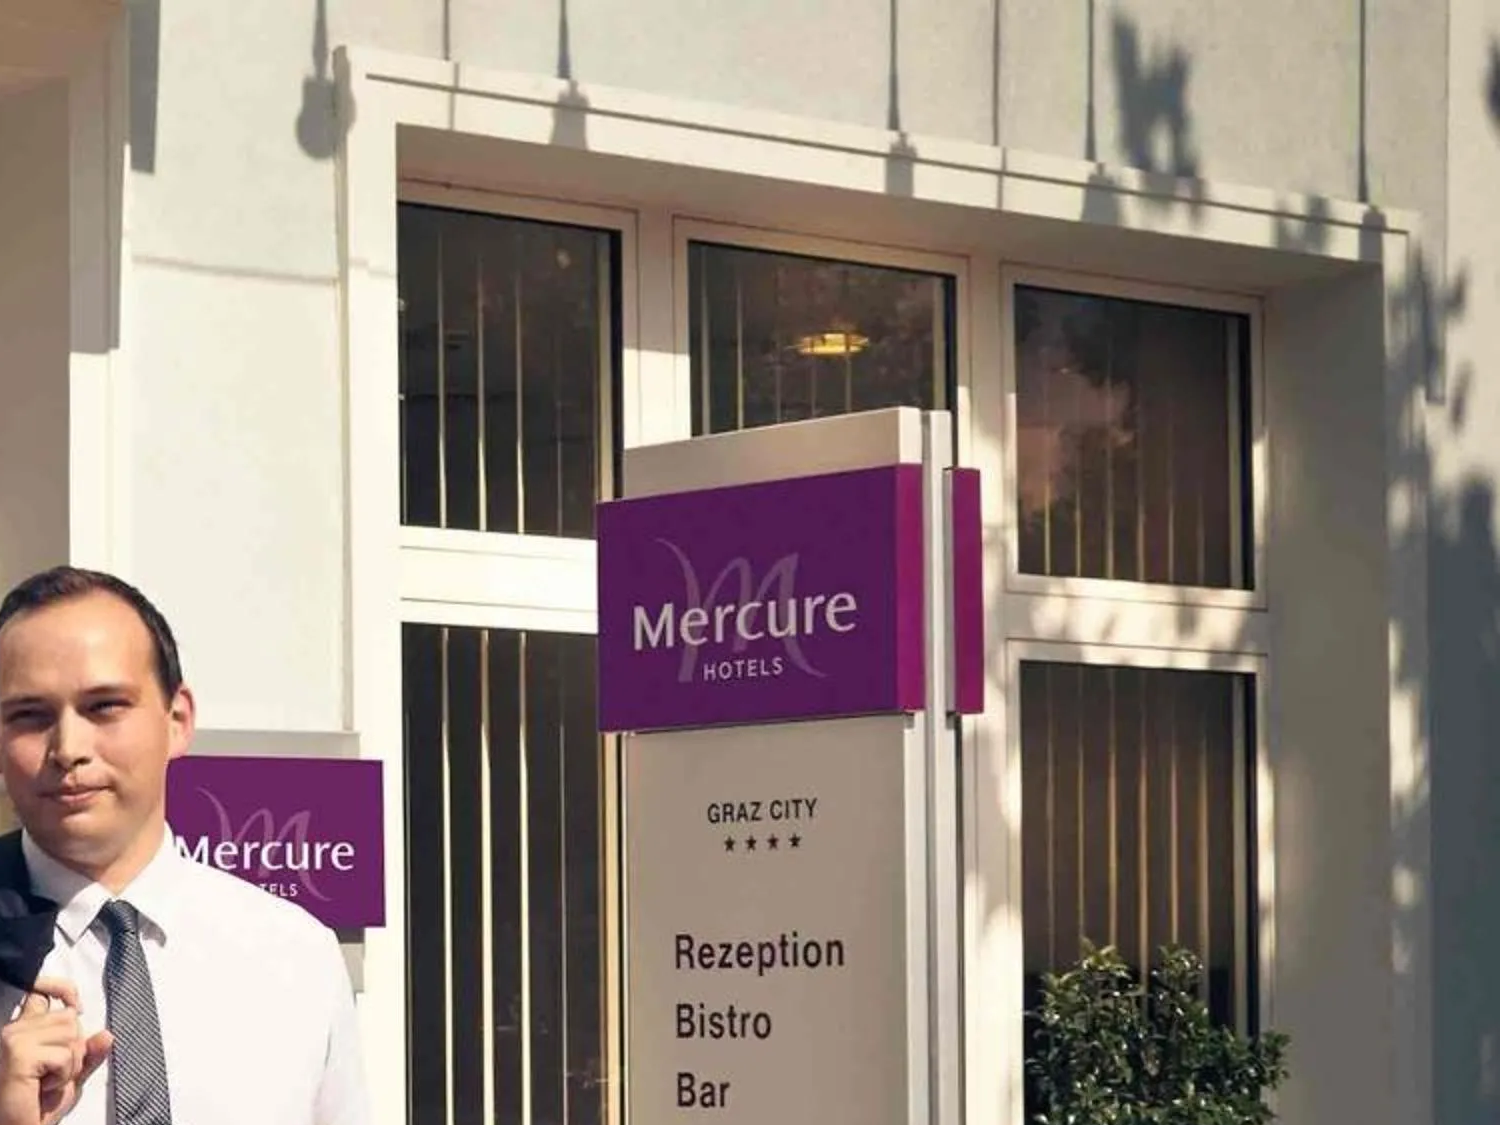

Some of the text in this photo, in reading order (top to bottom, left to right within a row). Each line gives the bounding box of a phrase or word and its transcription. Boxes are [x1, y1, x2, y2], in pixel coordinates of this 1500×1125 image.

[632, 591, 858, 652] Mercure
[703, 656, 784, 681] HOTELS
[707, 797, 818, 824] GRAZ CITY
[174, 834, 356, 871] Mercure
[259, 882, 299, 898] TELS
[674, 930, 846, 976] Rezeption
[675, 1002, 773, 1040] Bistro
[676, 1071, 731, 1109] Bar
